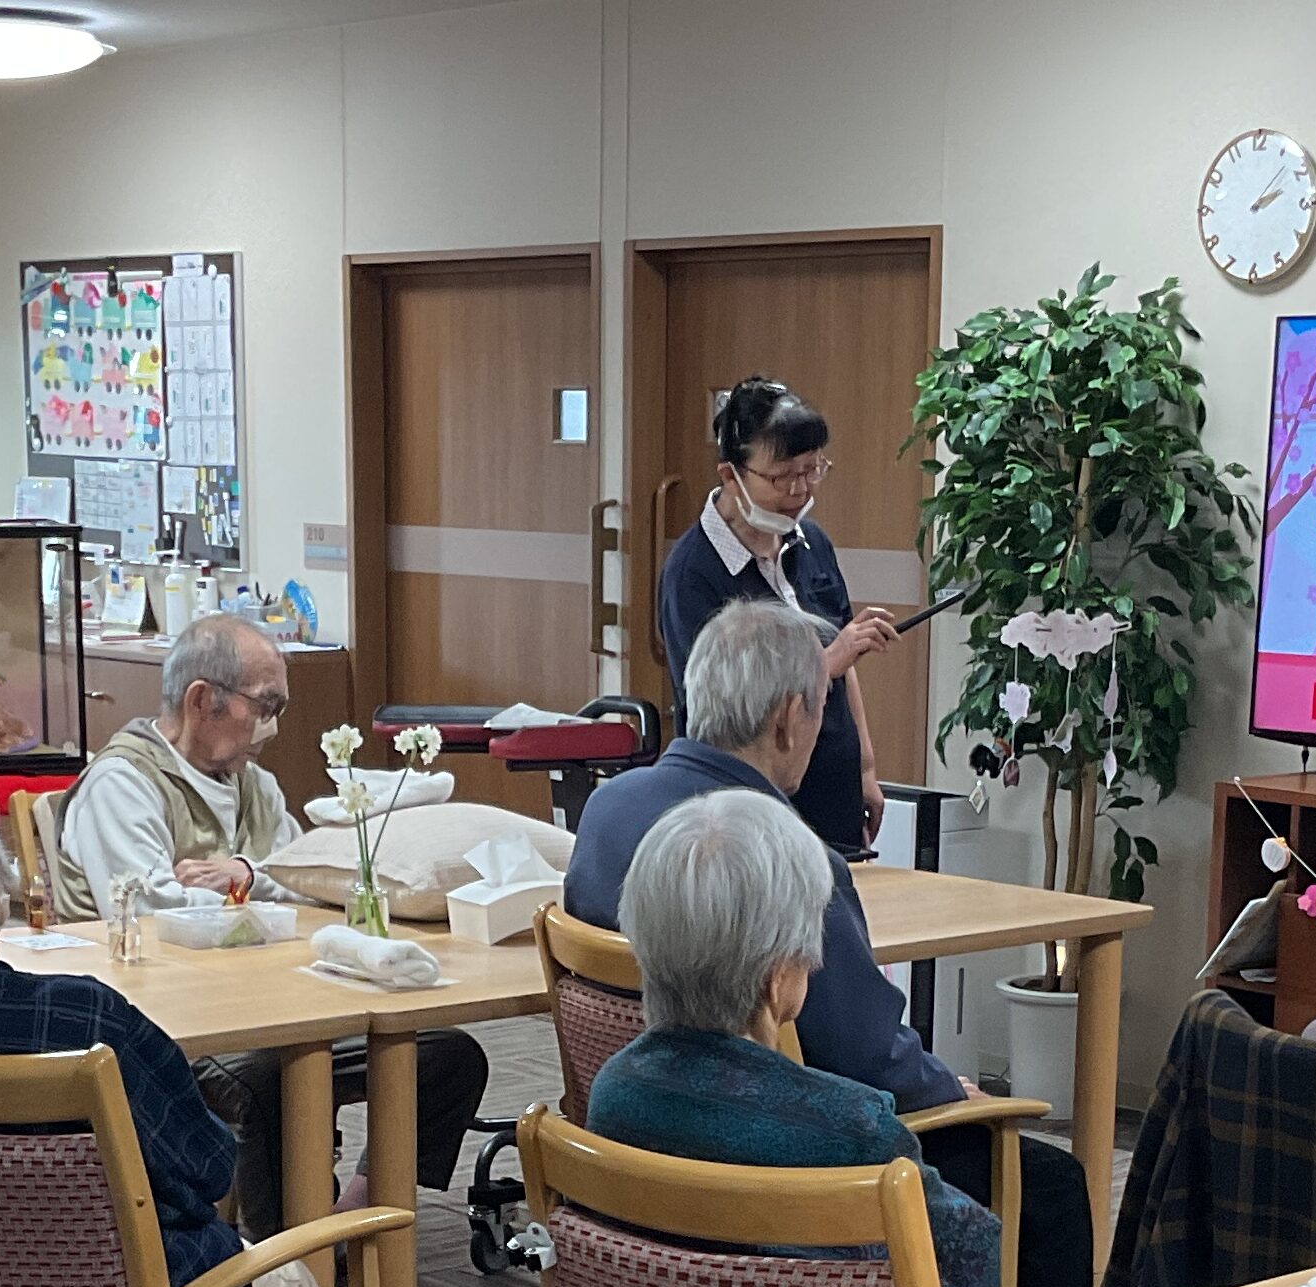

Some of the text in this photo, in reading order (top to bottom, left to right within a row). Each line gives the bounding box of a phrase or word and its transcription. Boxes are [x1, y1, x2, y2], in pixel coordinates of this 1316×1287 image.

[1252, 134, 1267, 151] 12
[1228, 143, 1242, 163] 11
[1209, 168, 1223, 189] 10
[1293, 169, 1308, 182] 2
[1201, 205, 1214, 217] 9
[1204, 234, 1219, 251] 8
[1223, 254, 1236, 270] 7
[1248, 262, 1258, 283] 6
[307, 526, 325, 541] 210
